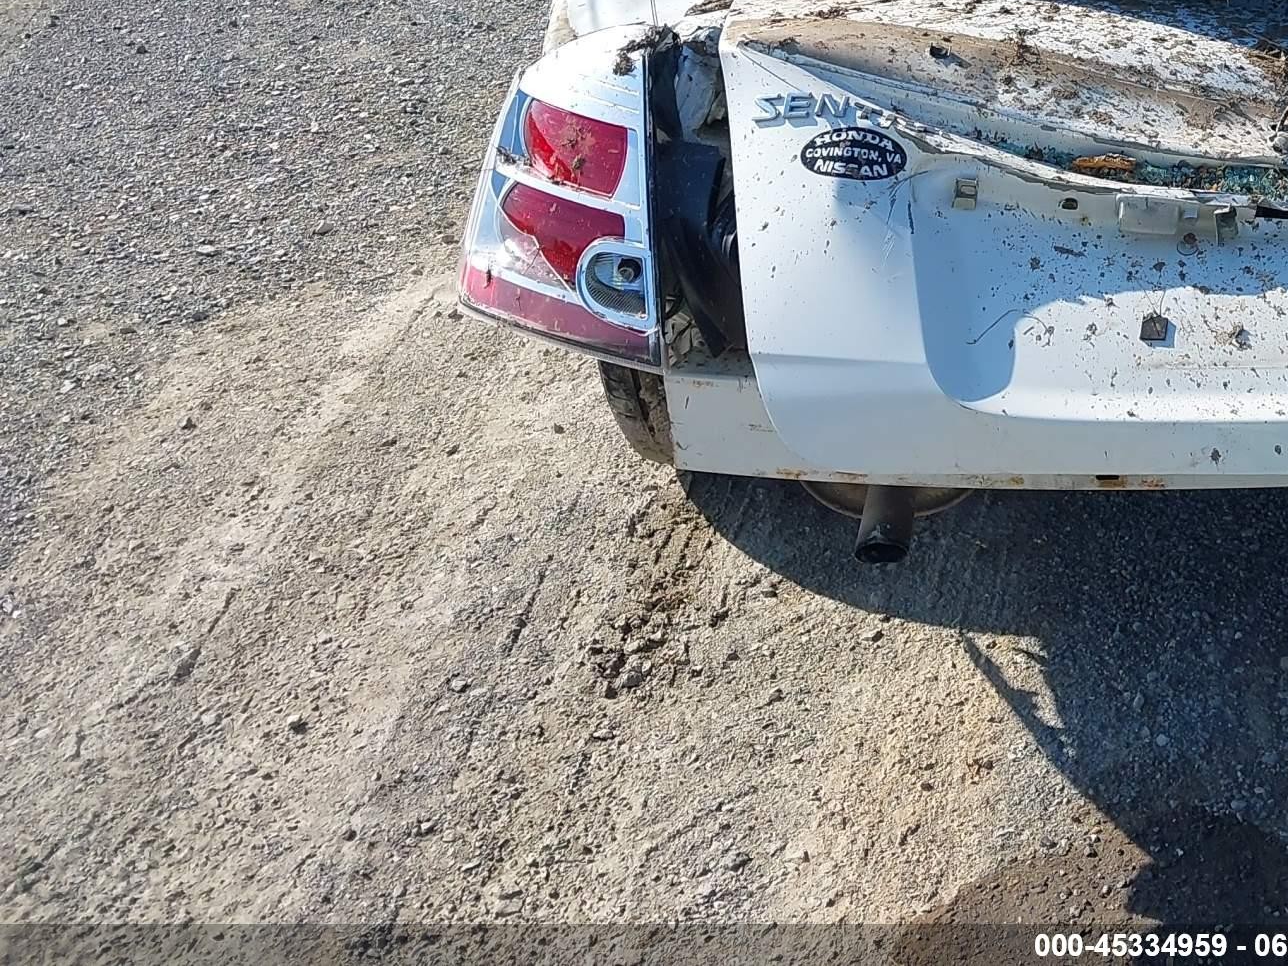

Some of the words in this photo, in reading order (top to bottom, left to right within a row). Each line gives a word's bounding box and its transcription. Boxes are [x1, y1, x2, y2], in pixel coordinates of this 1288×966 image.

[814, 130, 894, 151] HONDA
[805, 146, 882, 162] COVINGTON,
[886, 152, 902, 164] VA
[813, 159, 888, 177] NISSAN
